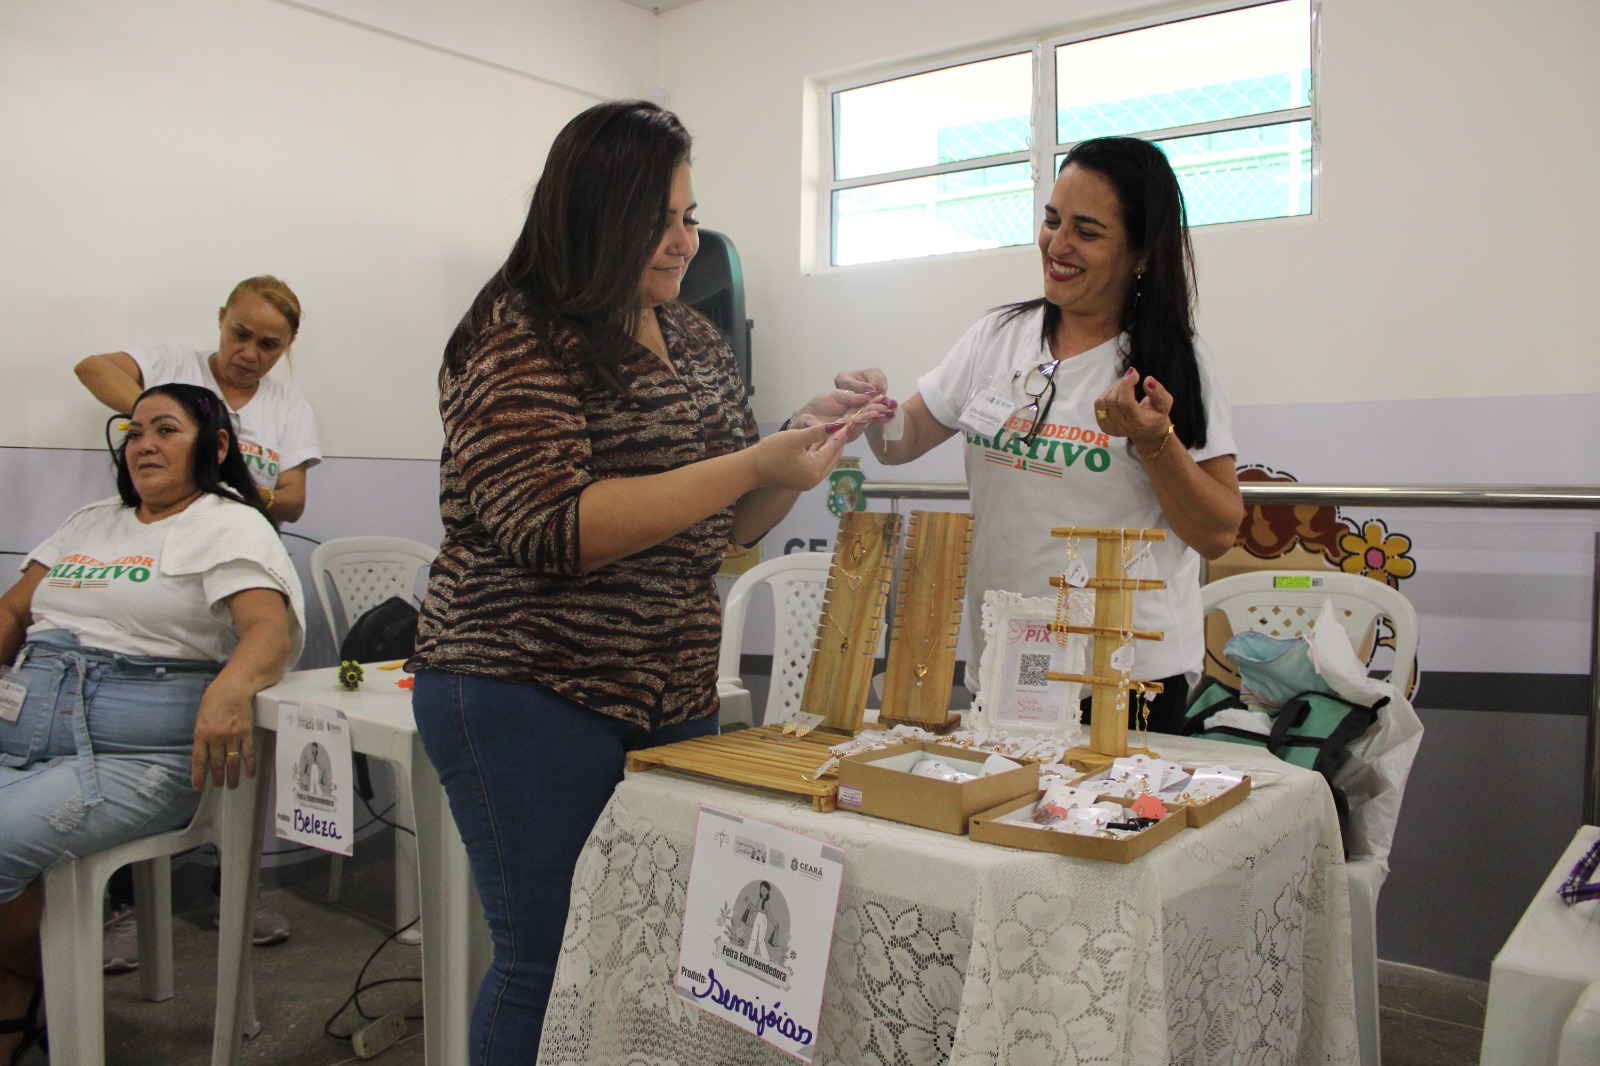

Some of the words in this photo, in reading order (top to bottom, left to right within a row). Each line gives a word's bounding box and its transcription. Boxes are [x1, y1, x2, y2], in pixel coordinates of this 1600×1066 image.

[47, 563, 151, 583] RIATIVO
[1025, 629, 1051, 643] PIX
[294, 809, 342, 840] Beleza
[799, 862, 823, 877] CEARÁ
[722, 945, 739, 962] Feira
[739, 951, 787, 983] Empreendedora
[680, 965, 708, 985] Produto:
